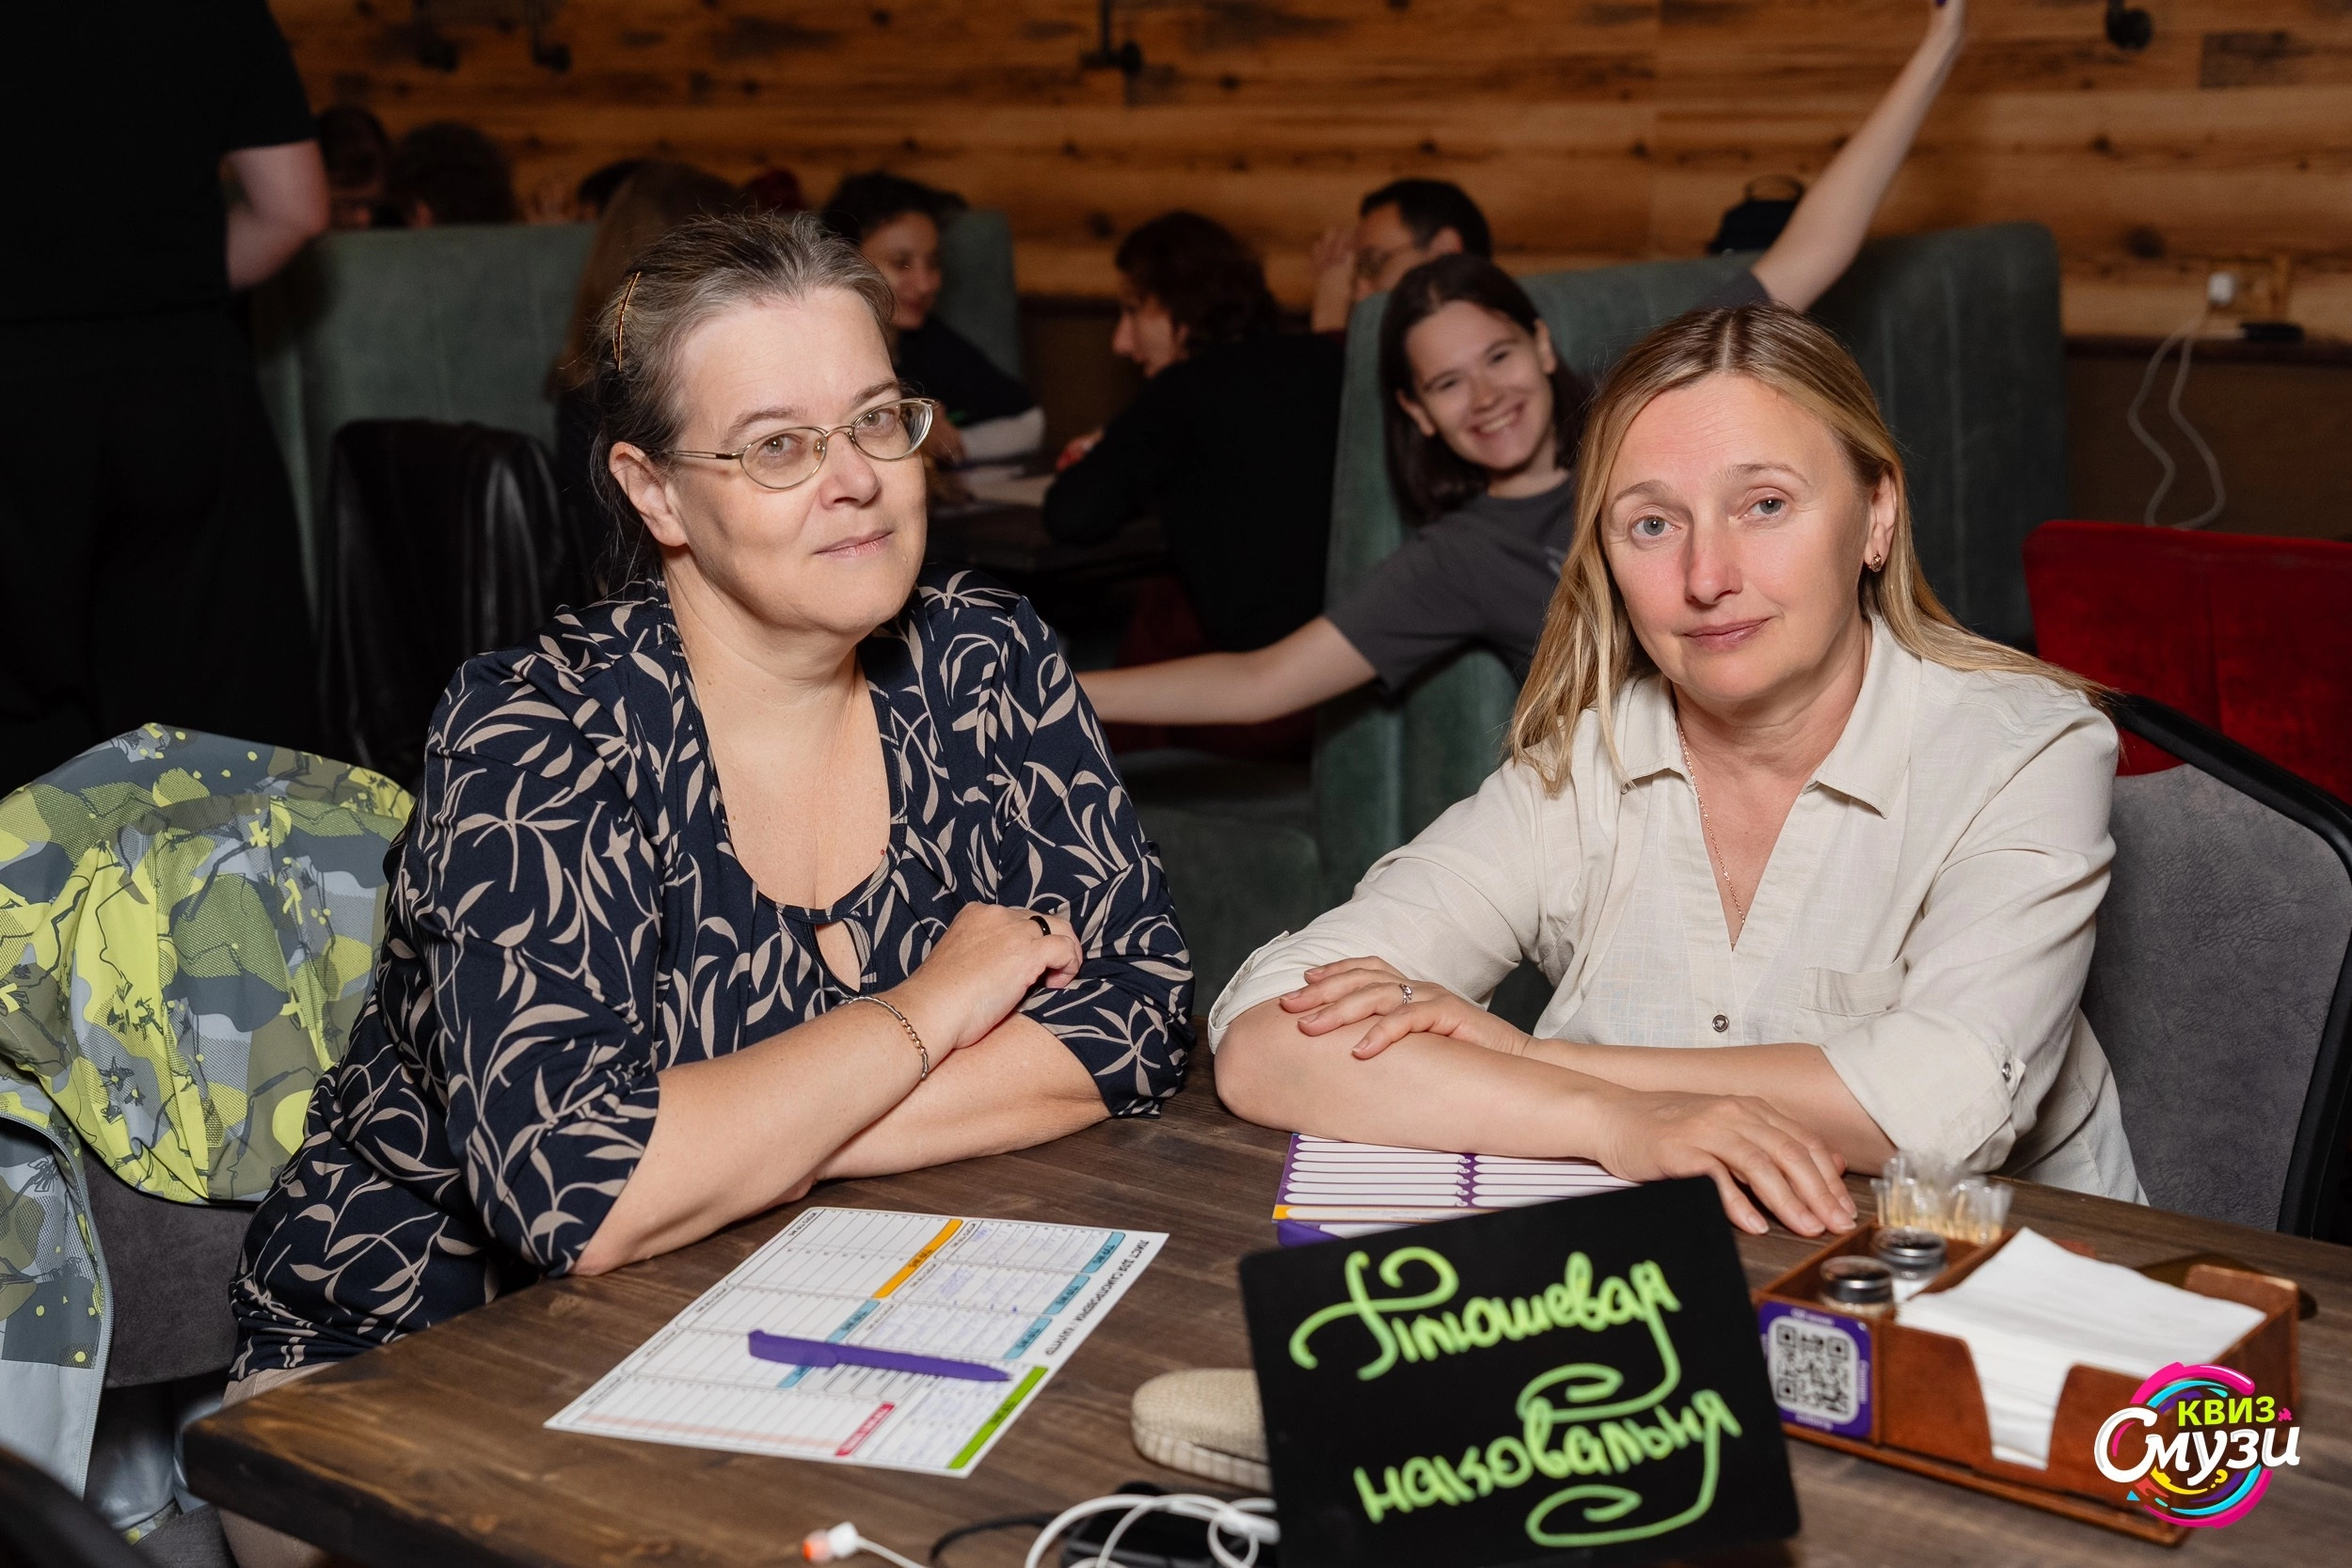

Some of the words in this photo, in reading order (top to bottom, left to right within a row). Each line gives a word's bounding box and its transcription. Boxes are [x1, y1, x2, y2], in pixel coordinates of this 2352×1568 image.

[1128, 1239, 1151, 1259] ЛИСТ
[1118, 1259, 1136, 1272] ДЛЯ
[1352, 1388, 1742, 1547] наковальня
